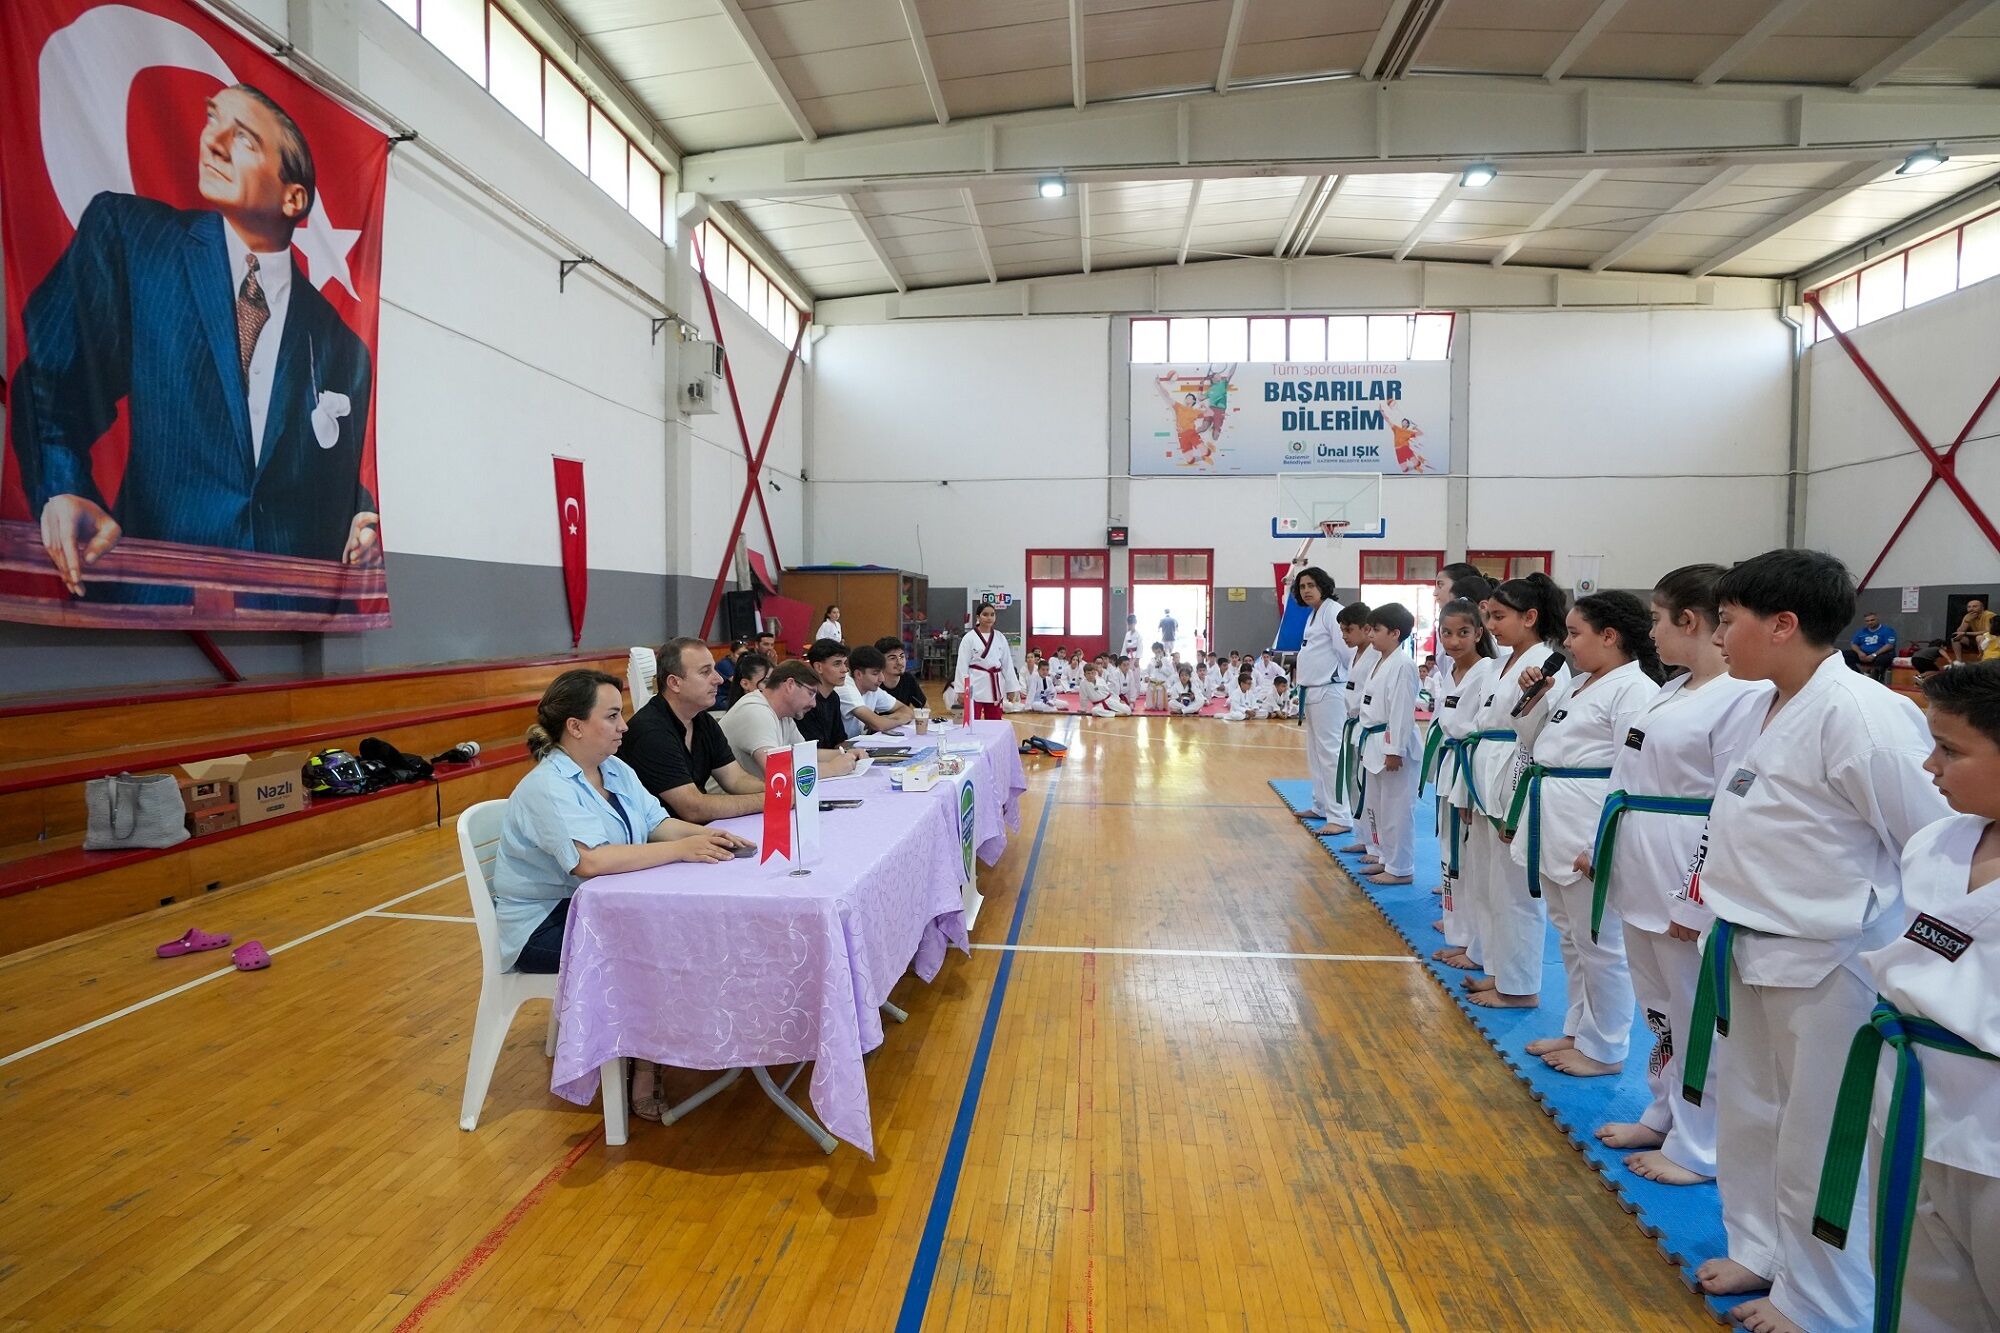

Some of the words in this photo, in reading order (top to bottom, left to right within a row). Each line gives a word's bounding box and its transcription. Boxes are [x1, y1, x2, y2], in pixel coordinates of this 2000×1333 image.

[1272, 363, 1299, 375] Tüm
[1264, 380, 1402, 403] BAŞARILAR
[1282, 406, 1384, 431] DİLERİM
[1317, 443, 1348, 457] Ünal
[1352, 445, 1379, 459] IŞIK
[256, 781, 293, 801] Nazlı
[1913, 921, 1967, 954] CANSEY
